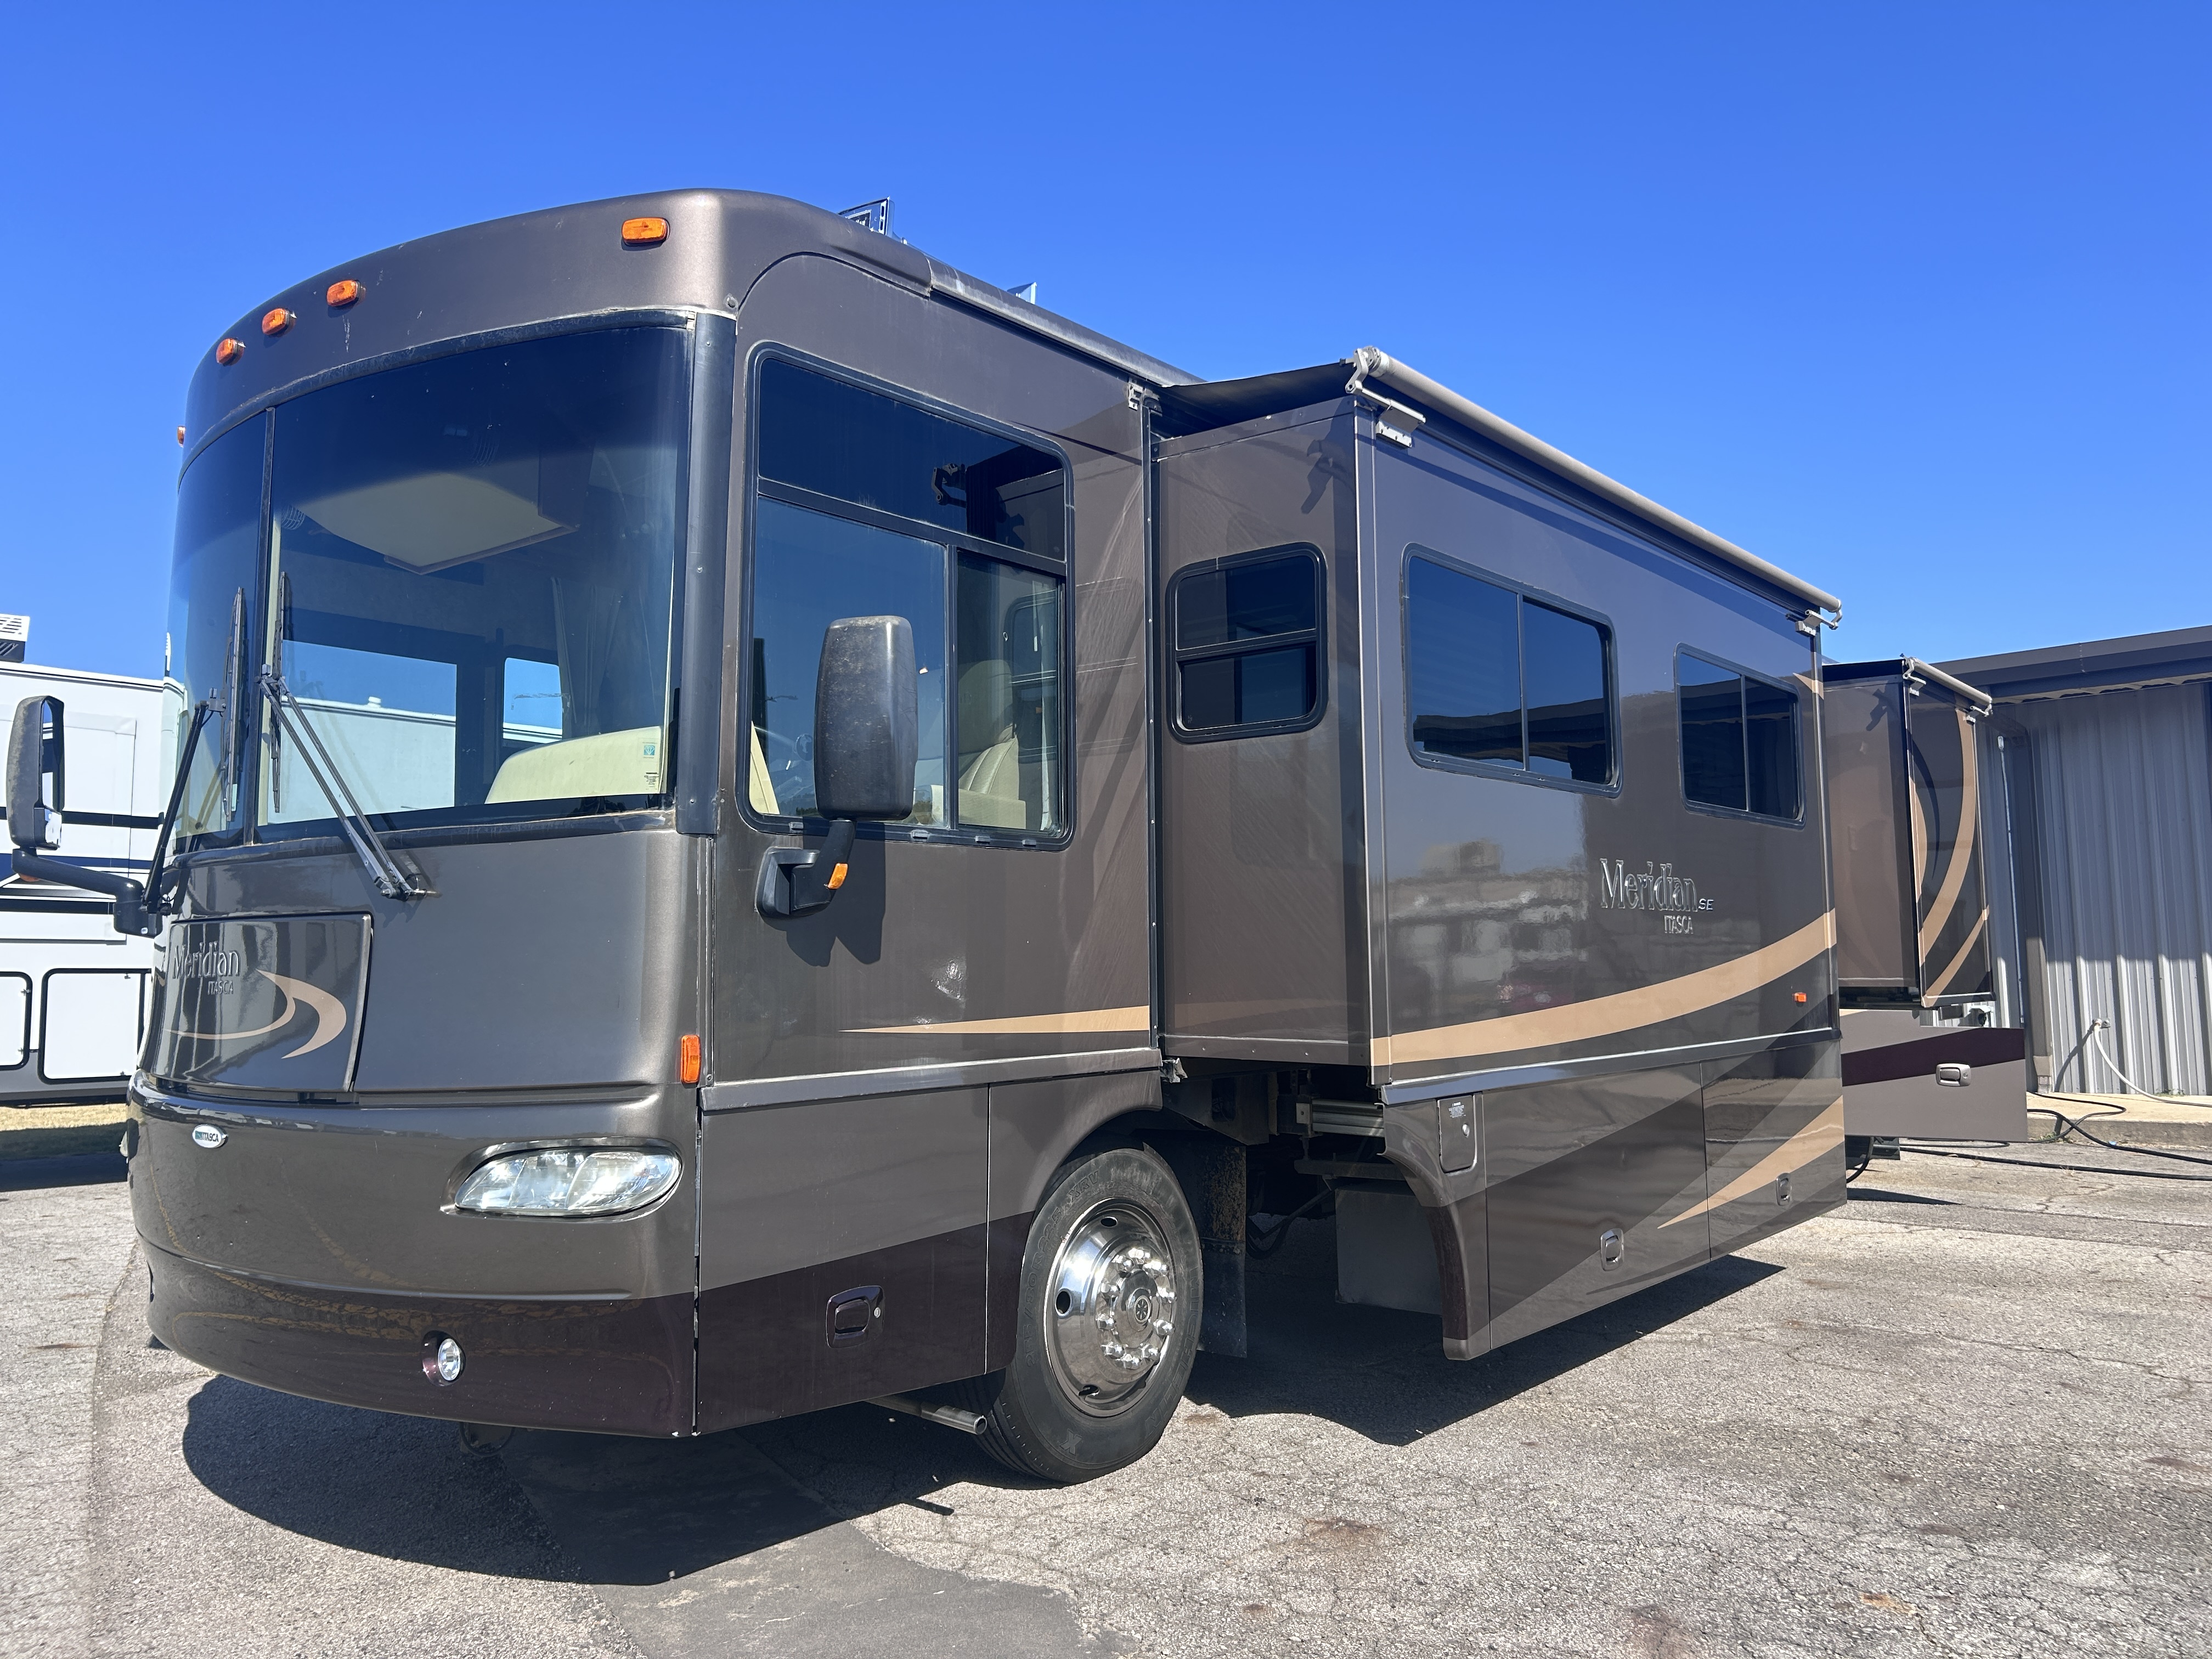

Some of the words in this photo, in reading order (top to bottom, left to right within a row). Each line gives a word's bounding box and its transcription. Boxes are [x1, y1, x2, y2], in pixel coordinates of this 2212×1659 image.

[1600, 858, 1697, 912] Meridian
[1698, 898, 1714, 911] SE
[1664, 915, 1694, 934] ITASCA
[172, 941, 240, 979] Meridian
[207, 980, 234, 995] ITASCA
[202, 1132, 219, 1142] ITASCA
[1068, 1170, 1099, 1203] XRV
[1145, 1266, 1200, 1437] MICHELIN
